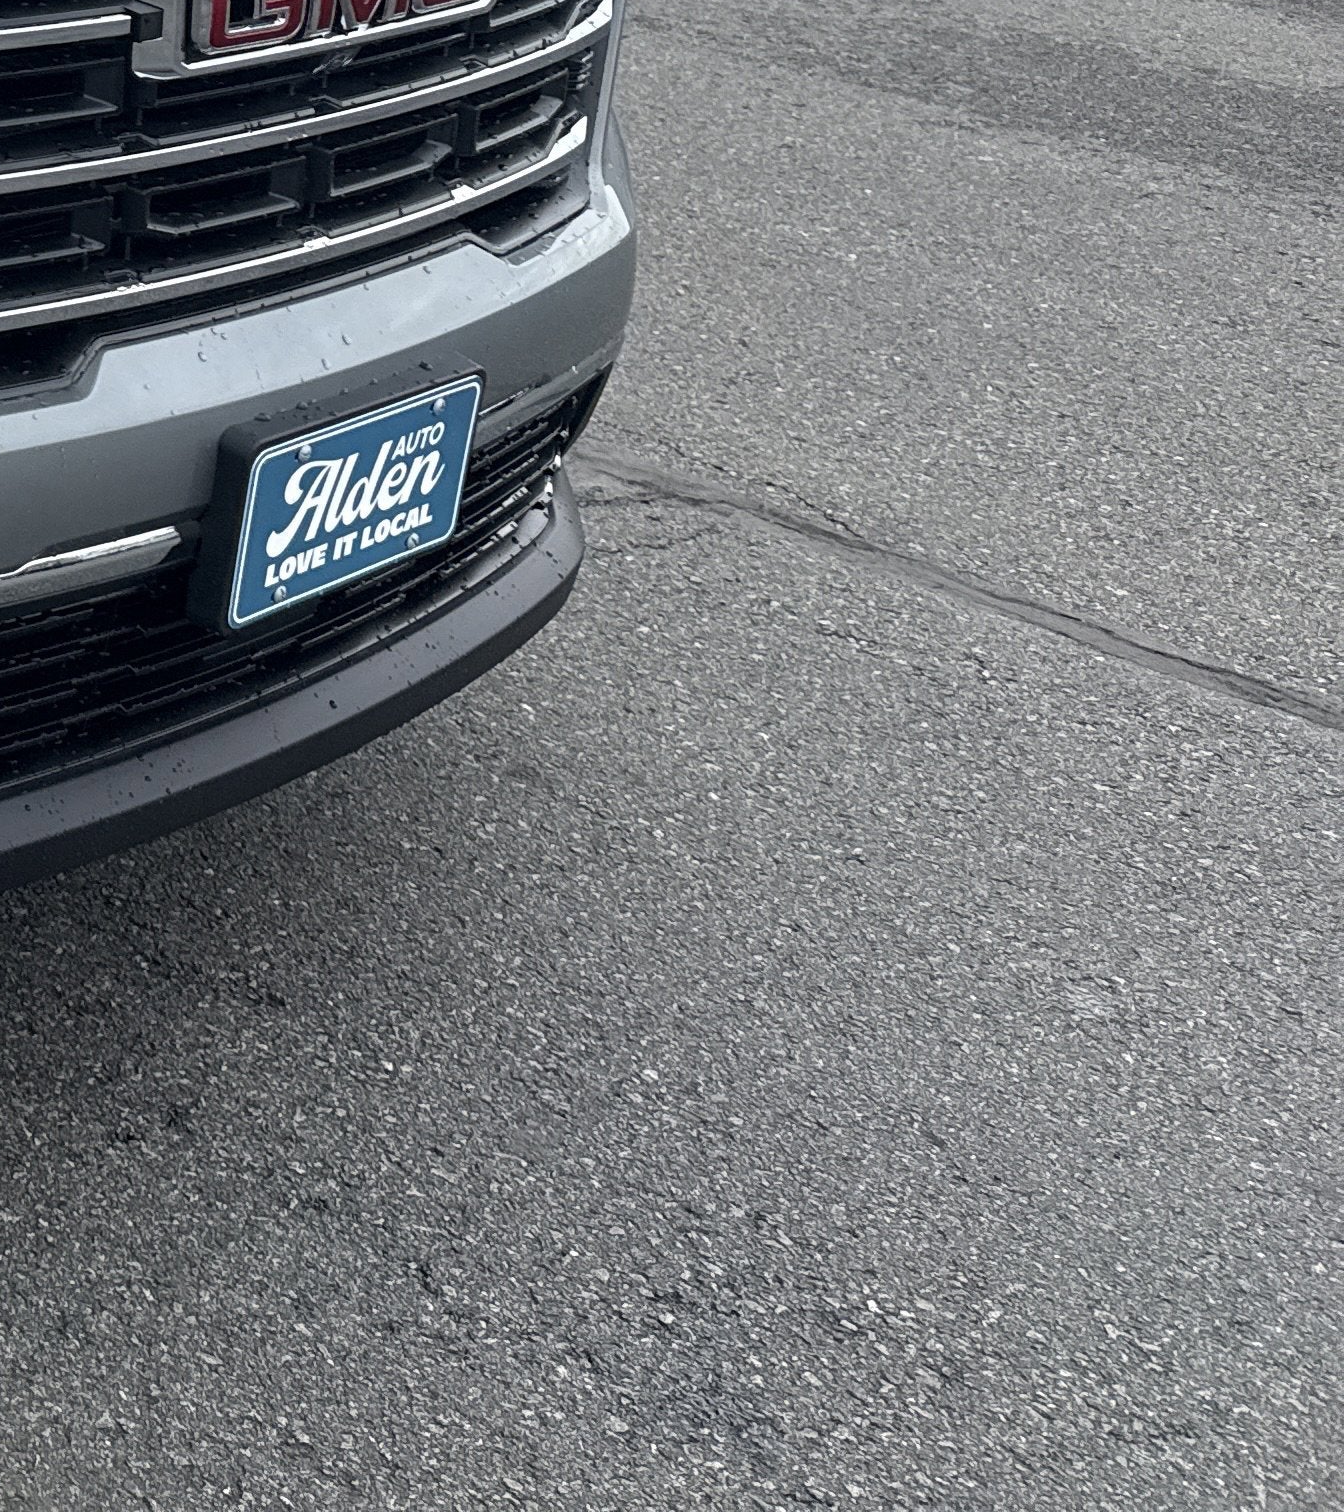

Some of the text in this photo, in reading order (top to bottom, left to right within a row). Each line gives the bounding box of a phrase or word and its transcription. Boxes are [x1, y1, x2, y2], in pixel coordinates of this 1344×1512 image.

[391, 421, 446, 460] AUTO
[265, 439, 446, 558] Alden
[264, 503, 433, 588] LOVE IT LOCAL
